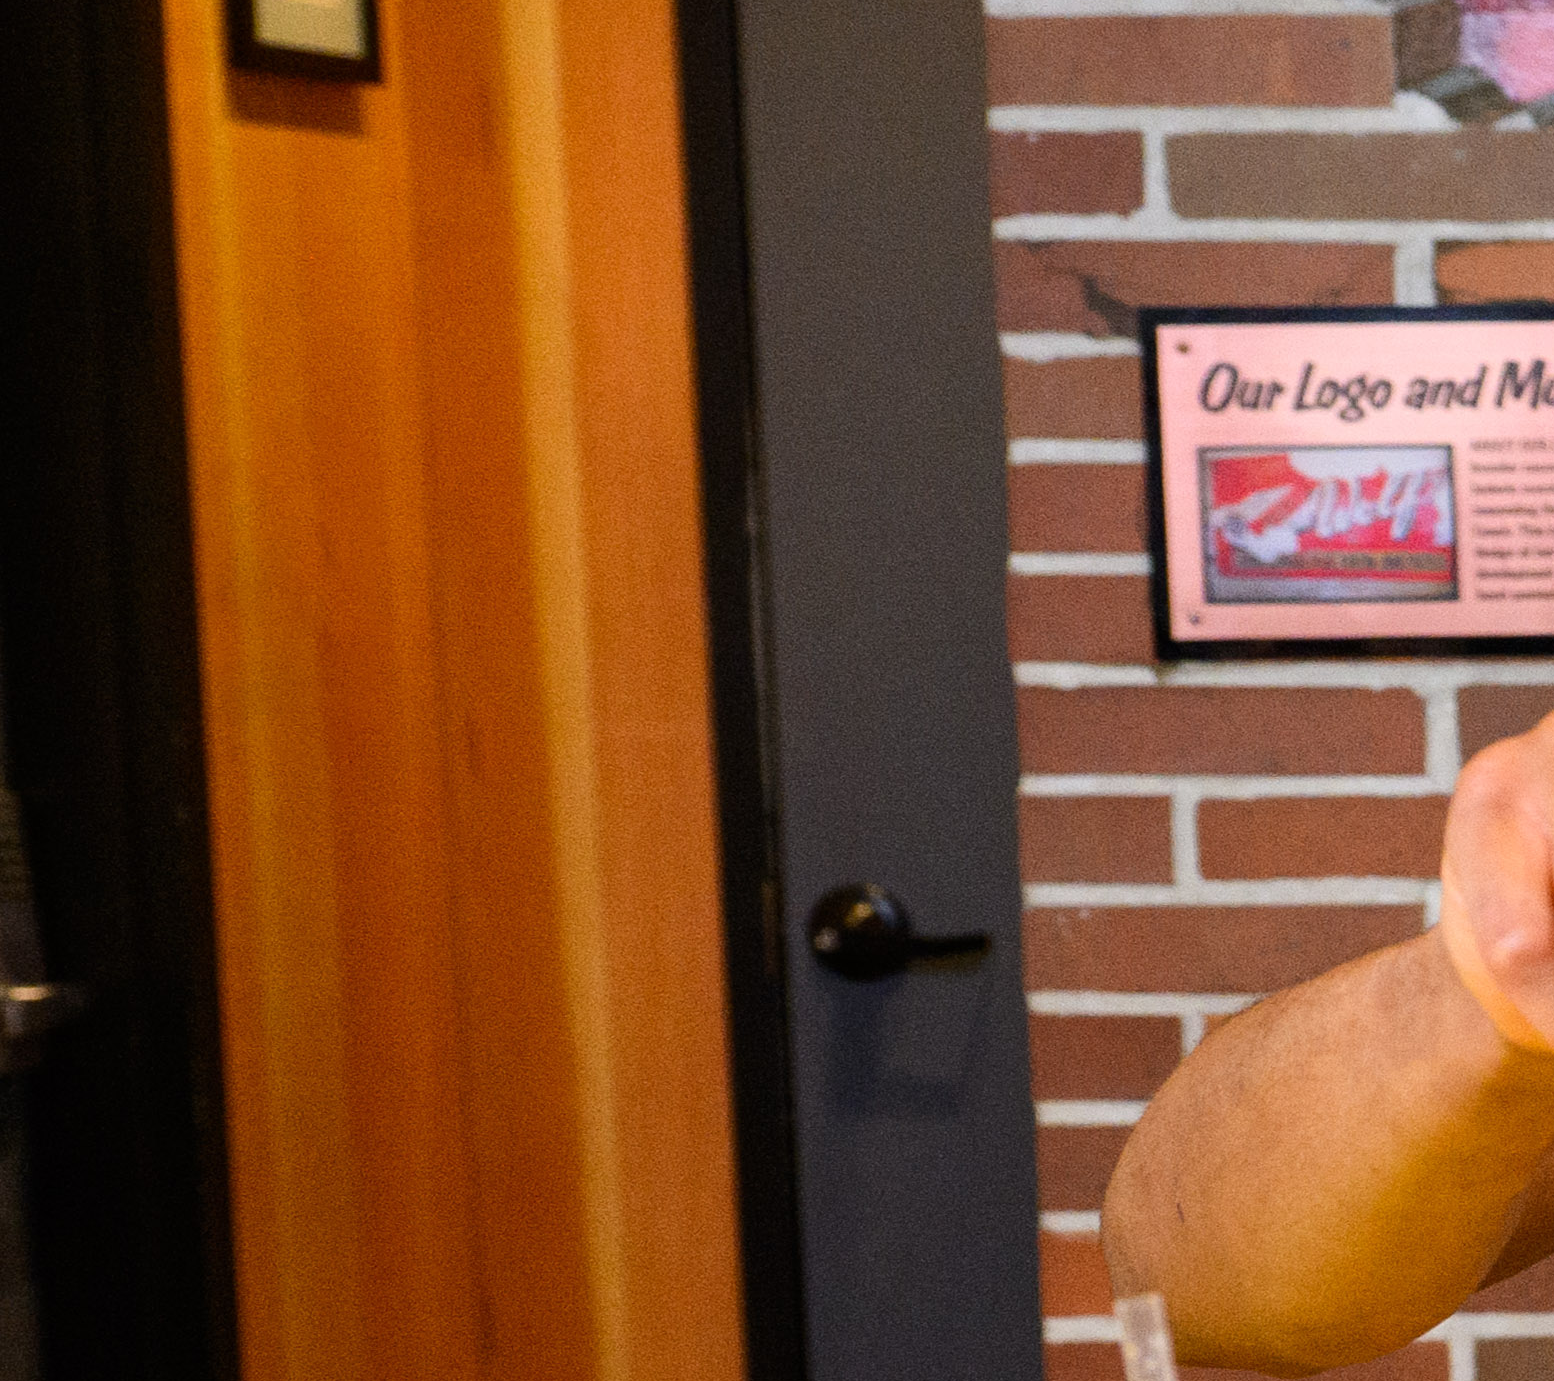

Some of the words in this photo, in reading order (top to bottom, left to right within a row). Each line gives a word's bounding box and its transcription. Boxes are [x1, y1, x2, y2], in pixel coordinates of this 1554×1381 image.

[1199, 361, 1285, 413] Our
[1293, 362, 1395, 421] Logo
[1405, 365, 1488, 409] and
